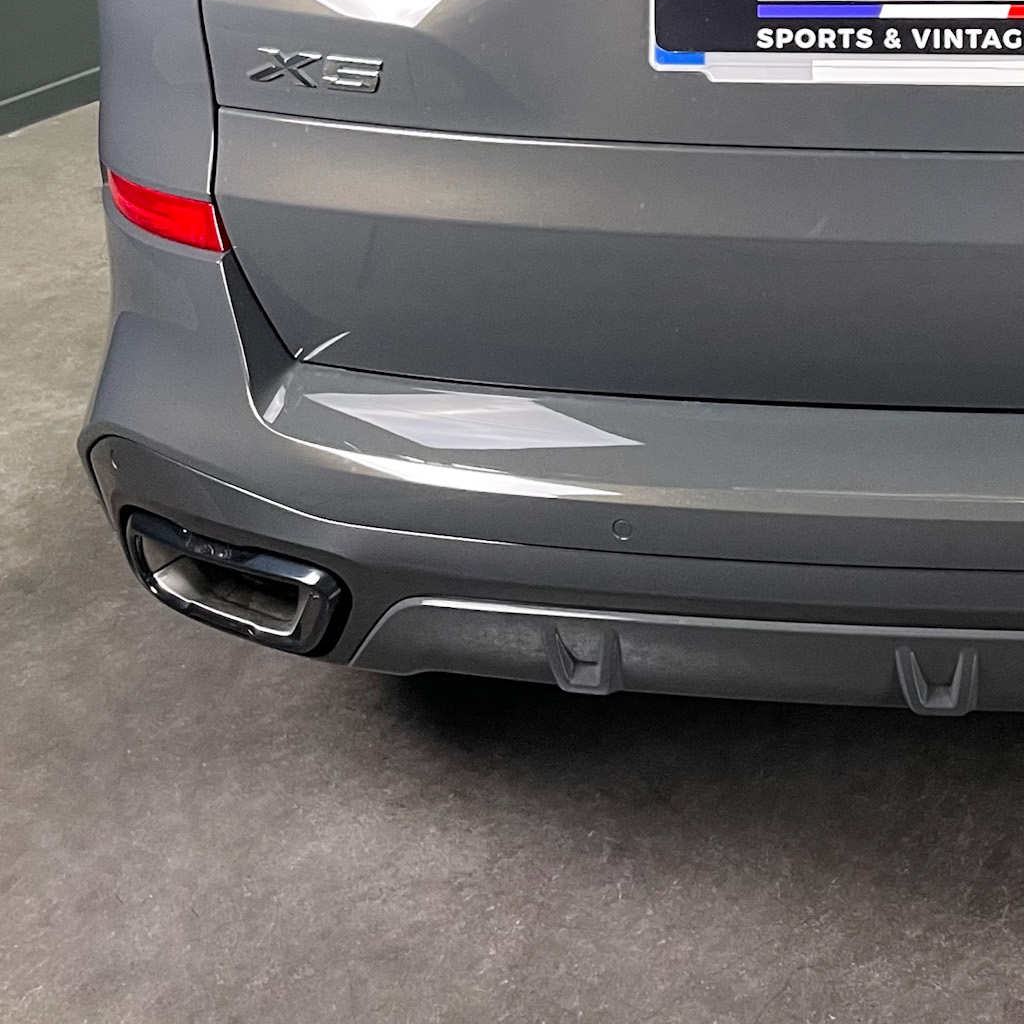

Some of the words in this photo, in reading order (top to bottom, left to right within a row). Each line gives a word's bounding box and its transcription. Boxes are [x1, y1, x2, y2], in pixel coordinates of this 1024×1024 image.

[757, 28, 873, 48] SPORTS
[884, 28, 901, 49] &
[247, 47, 384, 93] X5
